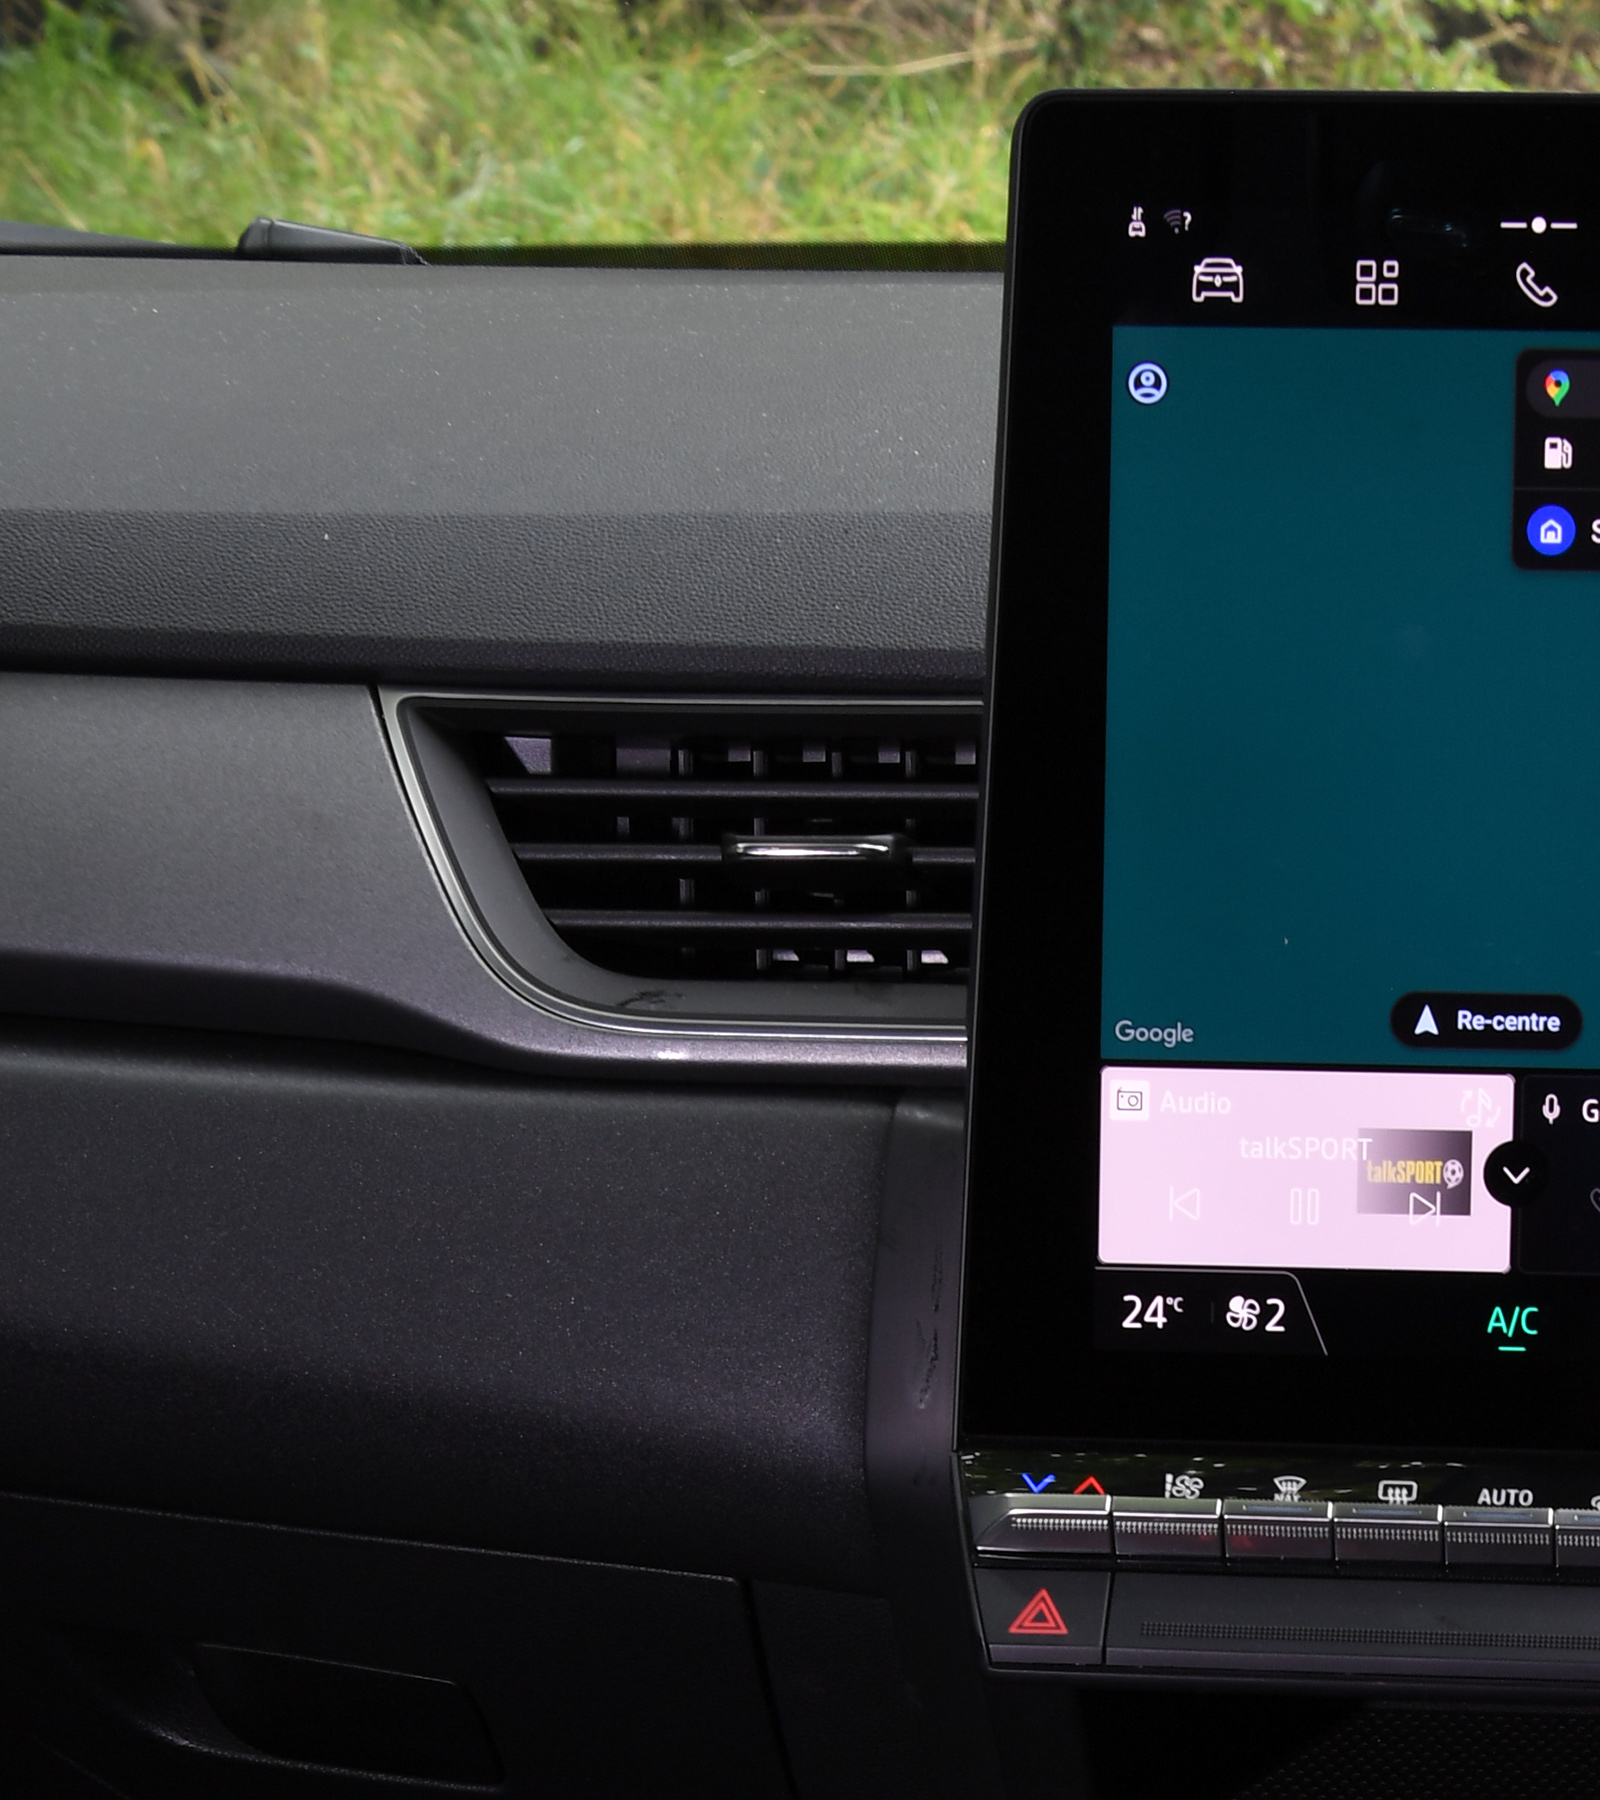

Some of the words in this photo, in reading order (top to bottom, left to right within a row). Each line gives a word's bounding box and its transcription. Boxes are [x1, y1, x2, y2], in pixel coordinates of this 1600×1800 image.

[1114, 1019, 1195, 1048] Google
[1457, 1009, 1562, 1033] Re-centre
[1159, 1090, 1232, 1115] Audio
[1238, 1135, 1374, 1162] talkSPORT
[1366, 1158, 1443, 1186] talkSPORT
[1264, 1297, 1286, 1332] 2
[1486, 1305, 1540, 1338] A/C
[1477, 1488, 1534, 1507] AUTO
